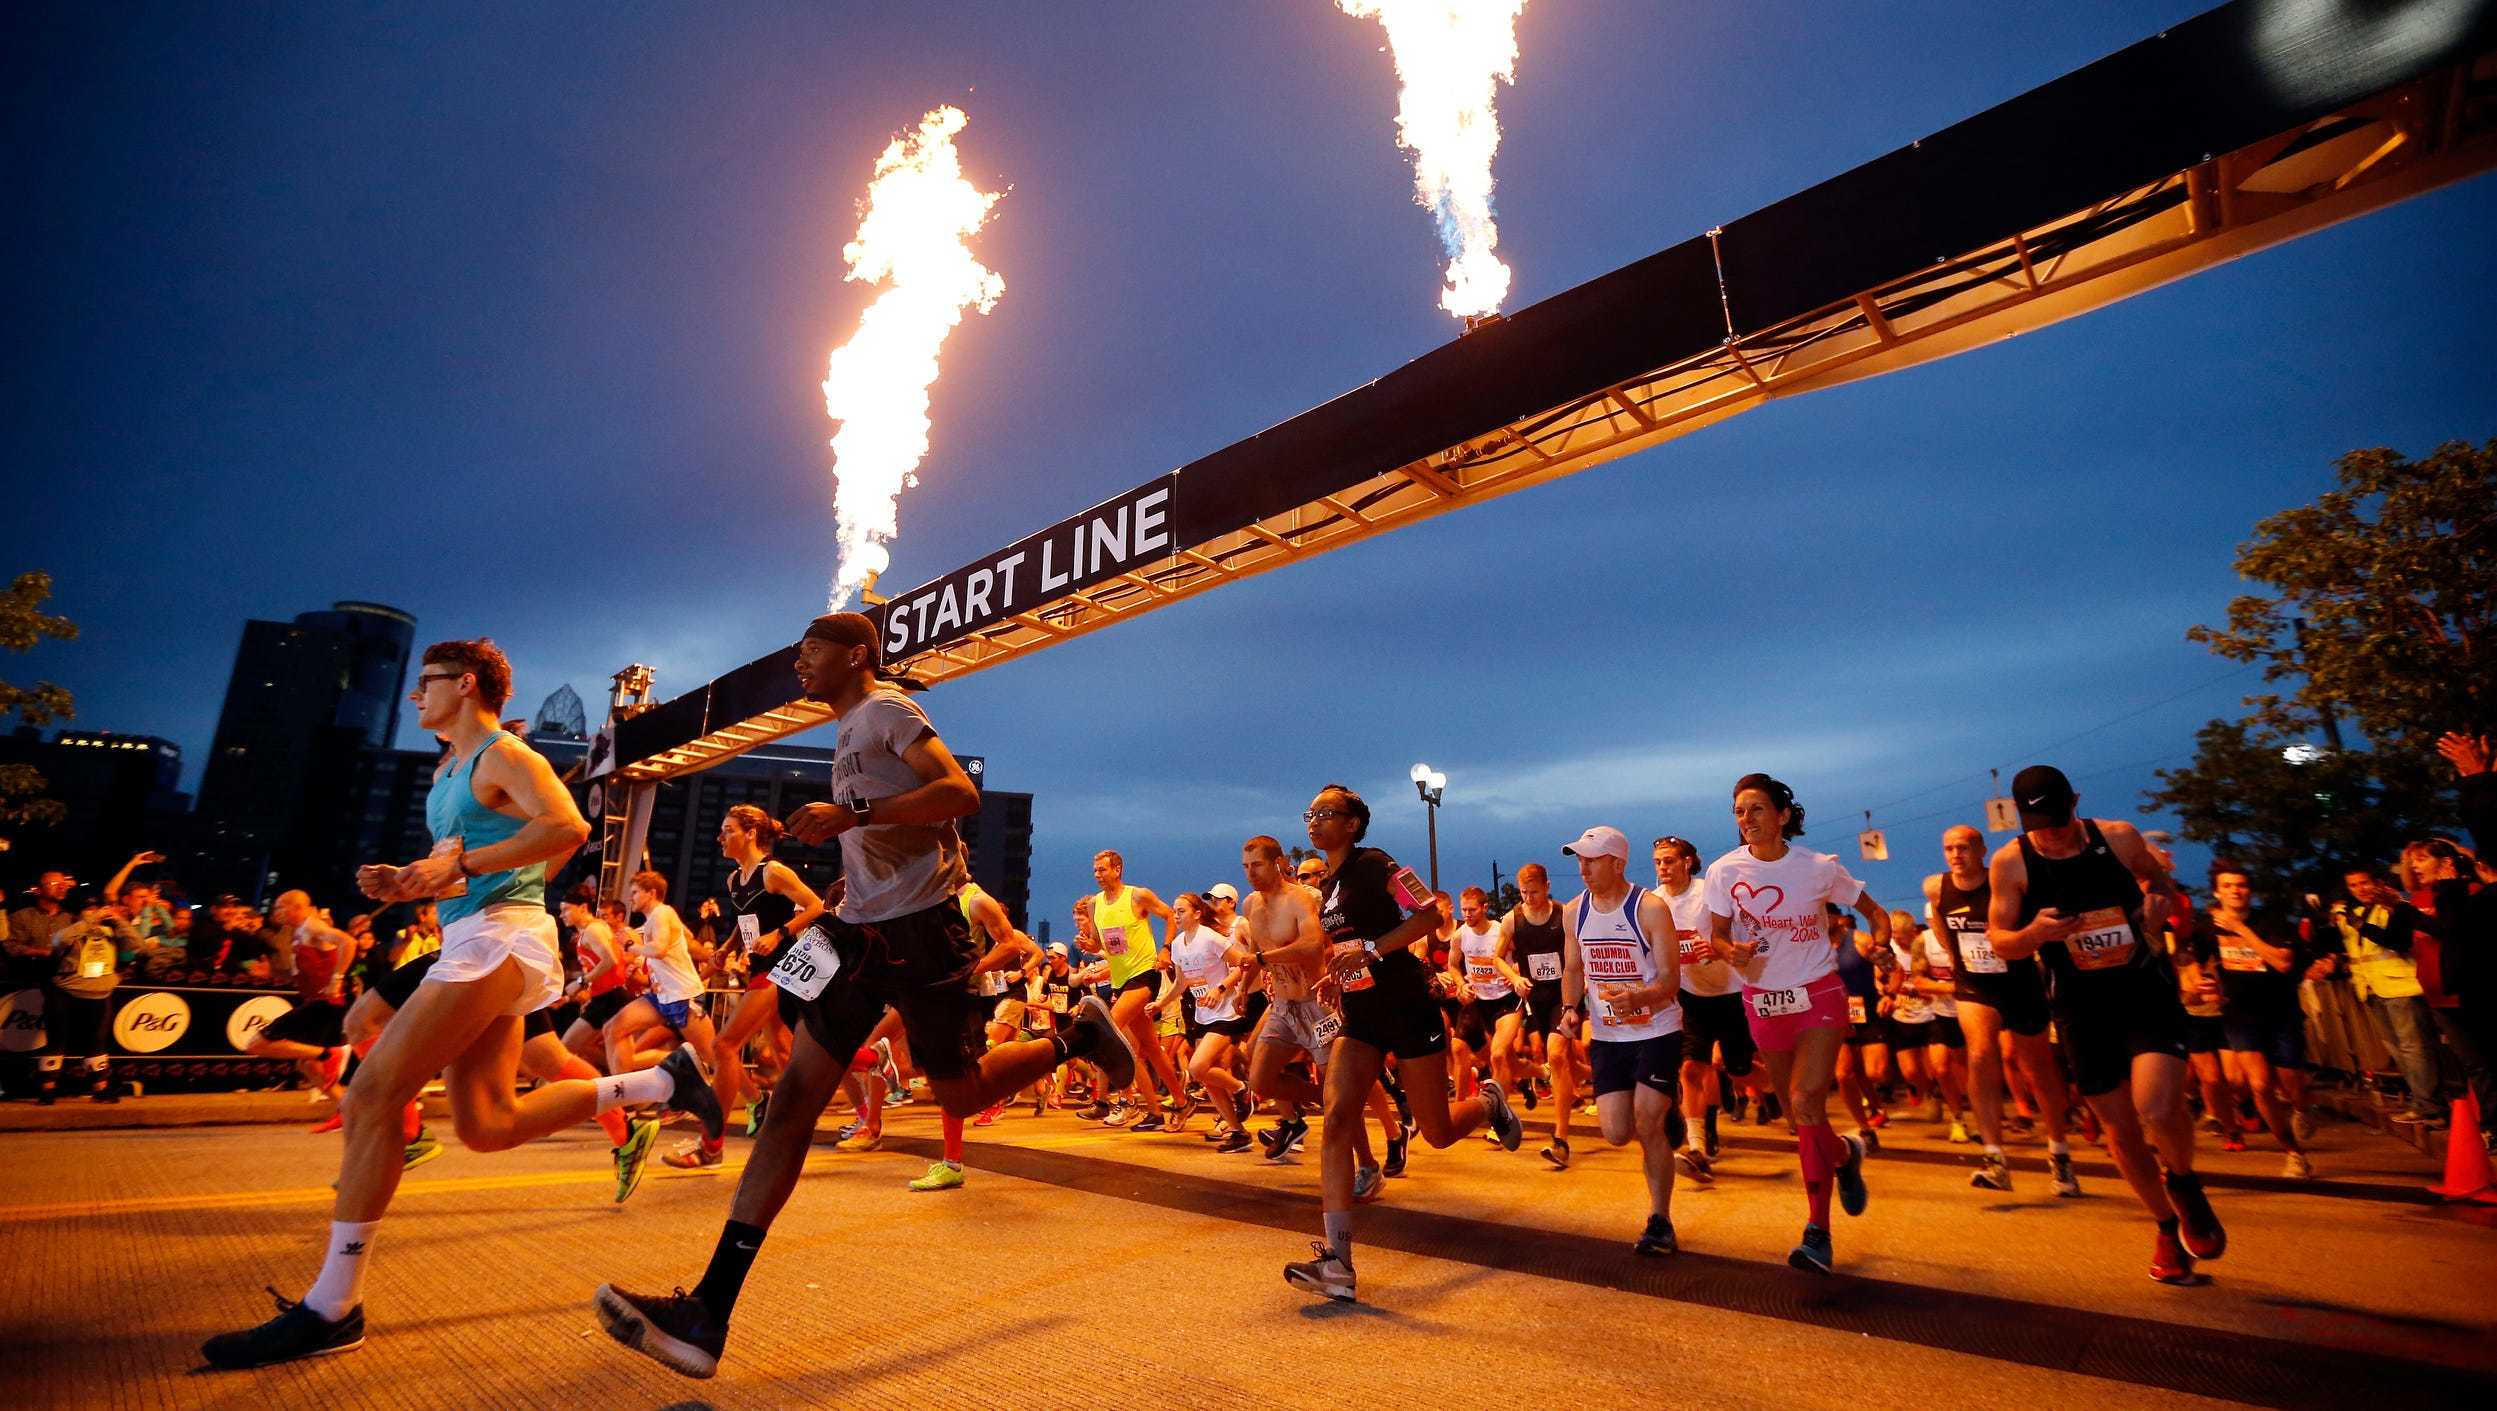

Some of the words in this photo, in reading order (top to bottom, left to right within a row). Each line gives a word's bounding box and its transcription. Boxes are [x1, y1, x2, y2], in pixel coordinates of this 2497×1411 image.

[886, 551, 1025, 653] START
[1041, 487, 1168, 594] LINE
[1761, 915, 1794, 929] Heart
[1946, 917, 1966, 929] EY
[2075, 931, 2122, 951] 19477
[1590, 947, 1631, 960] COLUMBIA
[1590, 961, 1614, 973] TRACK
[1615, 961, 1637, 973] CLUB
[1763, 989, 1796, 1007] 4773
[130, 1012, 183, 1032] P&G
